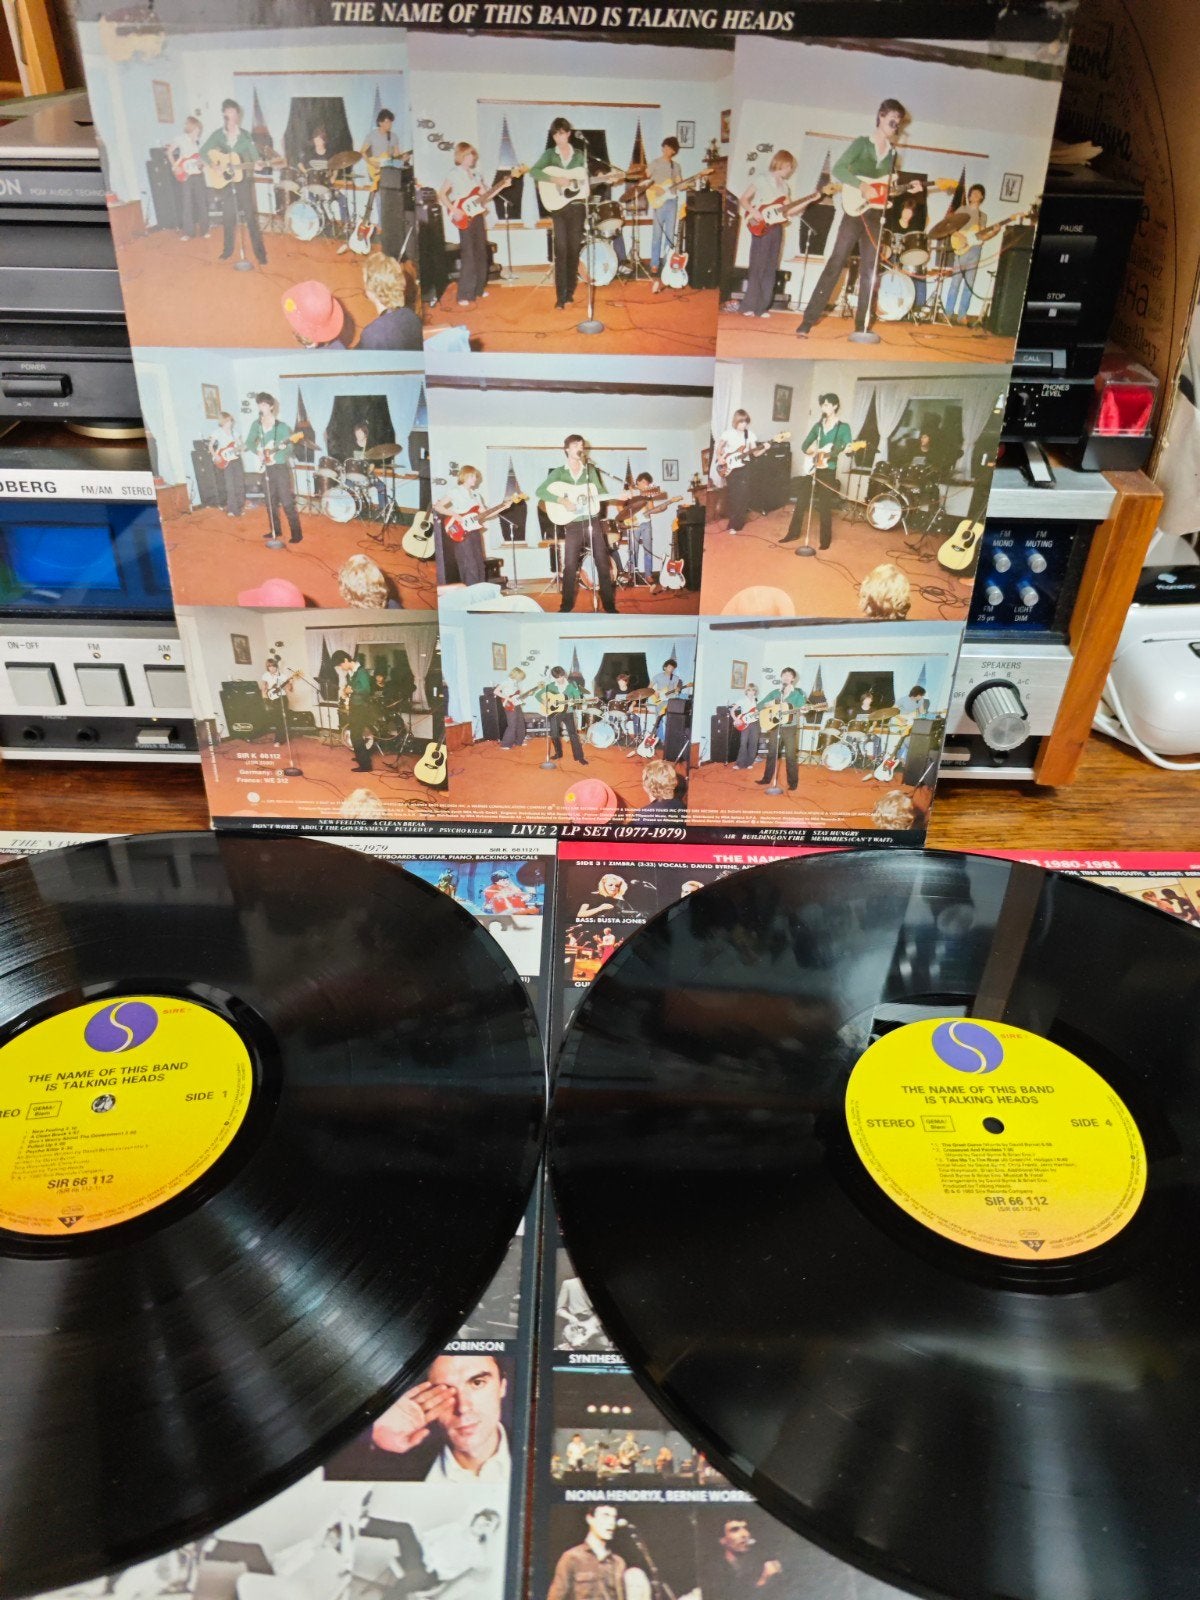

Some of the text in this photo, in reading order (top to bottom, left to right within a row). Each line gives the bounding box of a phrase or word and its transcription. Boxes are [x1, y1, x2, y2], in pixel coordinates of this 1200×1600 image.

[331, 2, 795, 31] THE NAME OF THIS BAND IS TALKING HEADS
[1060, 225, 1083, 233] PAUSE
[1047, 292, 1066, 300] STOP
[20, 363, 46, 371] POWER
[81, 485, 113, 495] FM/AM
[121, 486, 153, 496] STEREO
[1025, 540, 1054, 548] MUTING
[8, 641, 40, 649] ON-OFF
[88, 643, 100, 651] FM
[157, 644, 171, 652] AM
[981, 662, 1022, 670] SPEAKERS
[511, 825, 687, 839] LIVE 2 LP SET (1977-1979)
[713, 855, 743, 863] THE
[1043, 860, 1121, 869] 1980-1981
[28, 1061, 189, 1083] THE NAME OF THIS BAND
[45, 1074, 166, 1092] IS TALKING HEADS
[901, 1086, 1055, 1094] THE NAME OF THIS BAND
[184, 1090, 228, 1102] SIDE 1
[925, 1096, 1039, 1104] IS TALKING HEADS
[866, 1119, 916, 1128] STEREO
[1070, 1118, 1113, 1127] SIDE 4
[47, 1174, 114, 1189] SIR 66 112
[985, 1197, 1049, 1206] SIR 66 112
[565, 1490, 605, 1501] NONA
[665, 1490, 708, 1501] BERNIE
